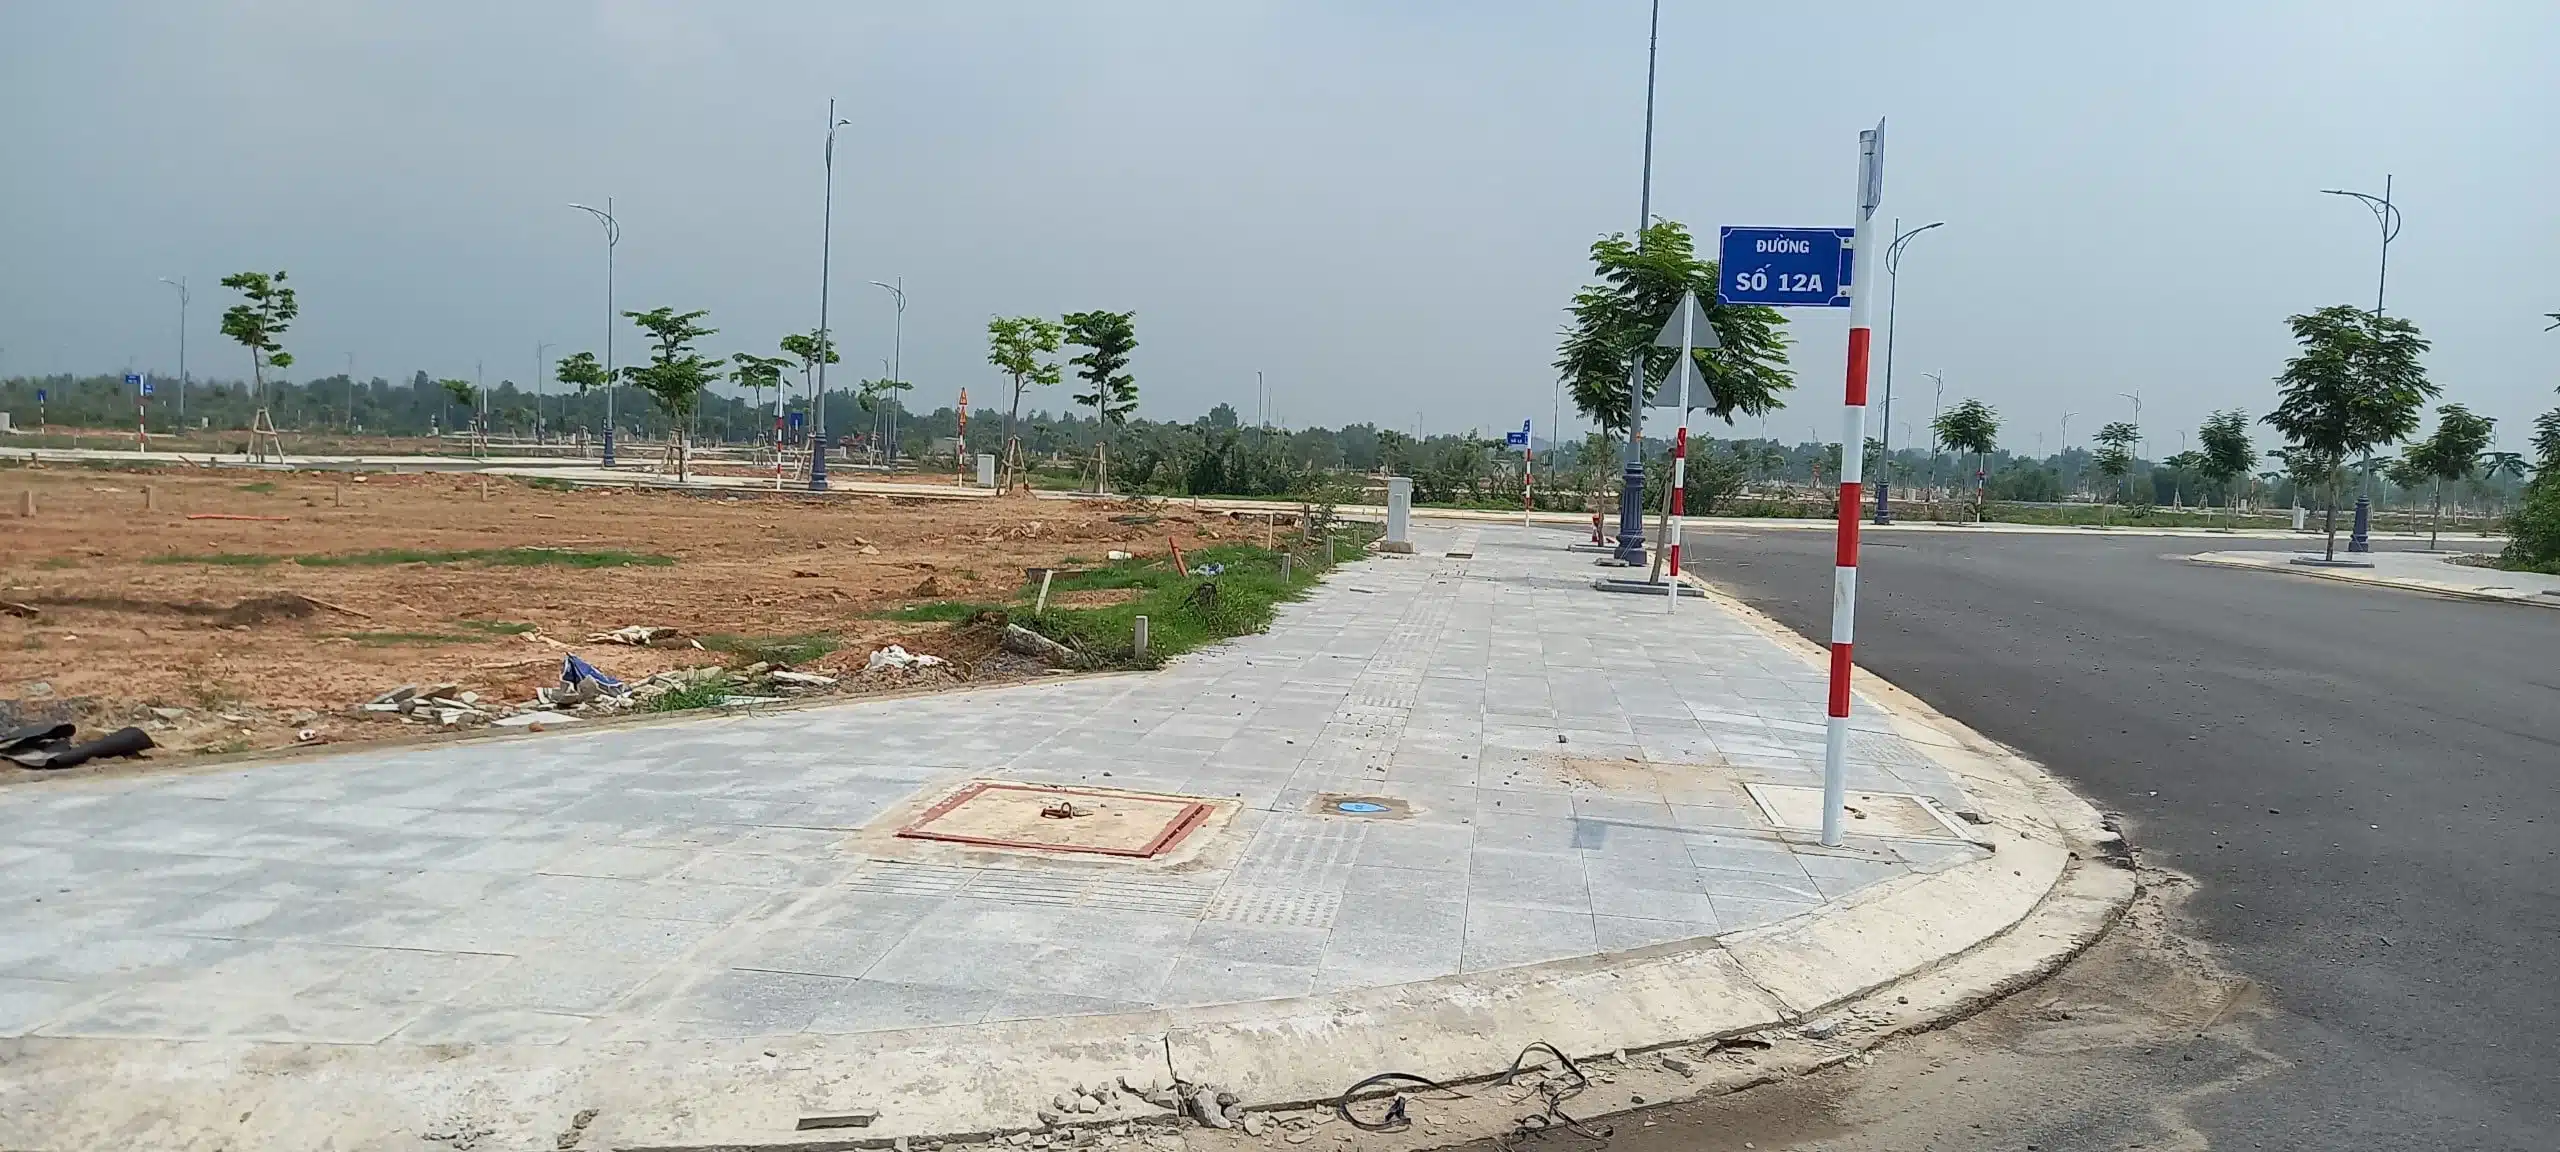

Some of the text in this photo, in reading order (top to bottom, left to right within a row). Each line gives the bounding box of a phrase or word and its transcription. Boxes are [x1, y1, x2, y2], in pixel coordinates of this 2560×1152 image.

[1756, 234, 1810, 254] ĐƯỜNG
[1736, 263, 1823, 292] SỐ 12A
